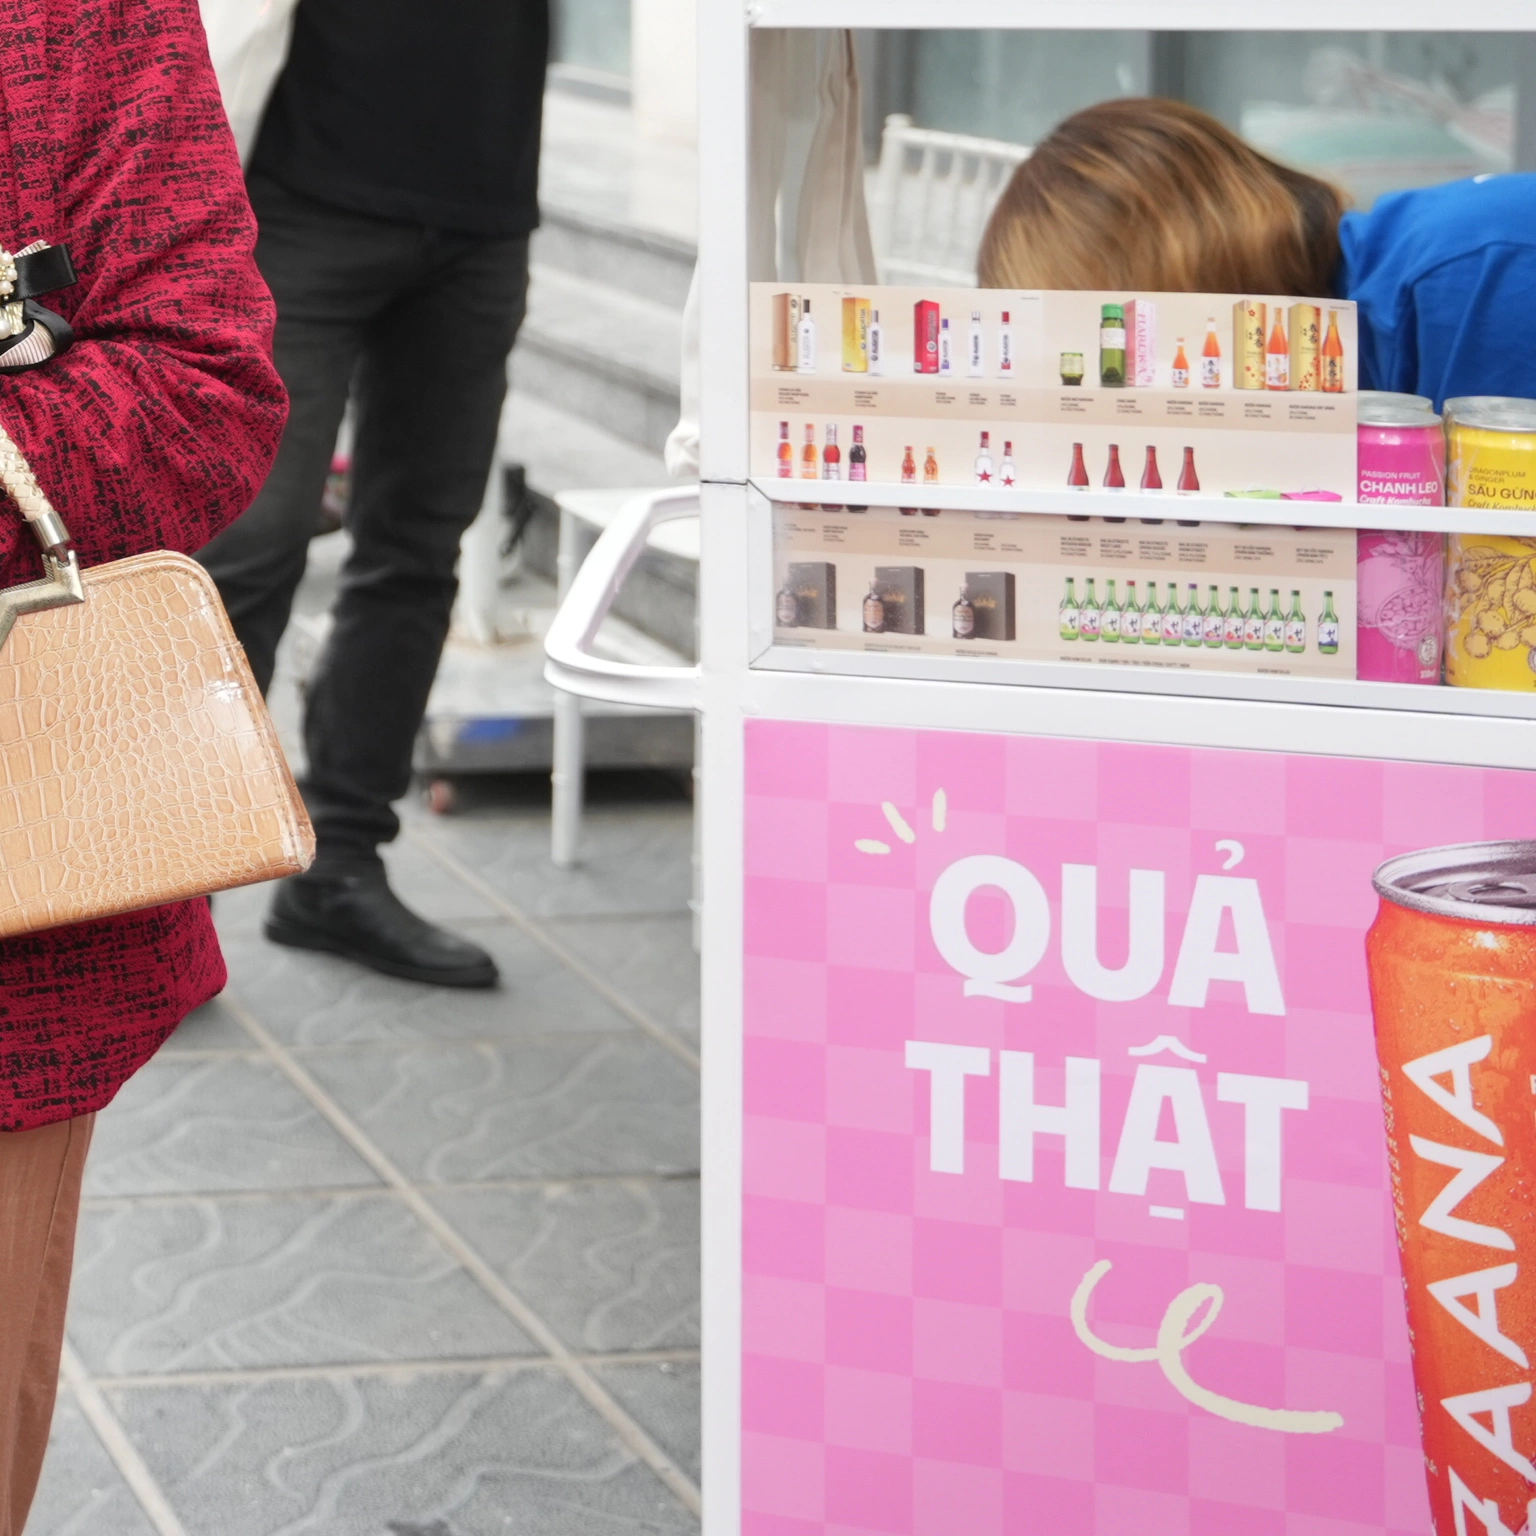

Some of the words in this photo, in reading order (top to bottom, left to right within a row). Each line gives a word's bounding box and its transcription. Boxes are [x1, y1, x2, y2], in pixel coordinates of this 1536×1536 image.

[1360, 480, 1412, 494] CHANH
[1418, 481, 1438, 493] LEO
[1361, 469, 1398, 479] PASSION
[1399, 472, 1421, 480] FRUIT
[929, 839, 1286, 1017] QUẢ
[904, 1035, 1310, 1221] THẬT
